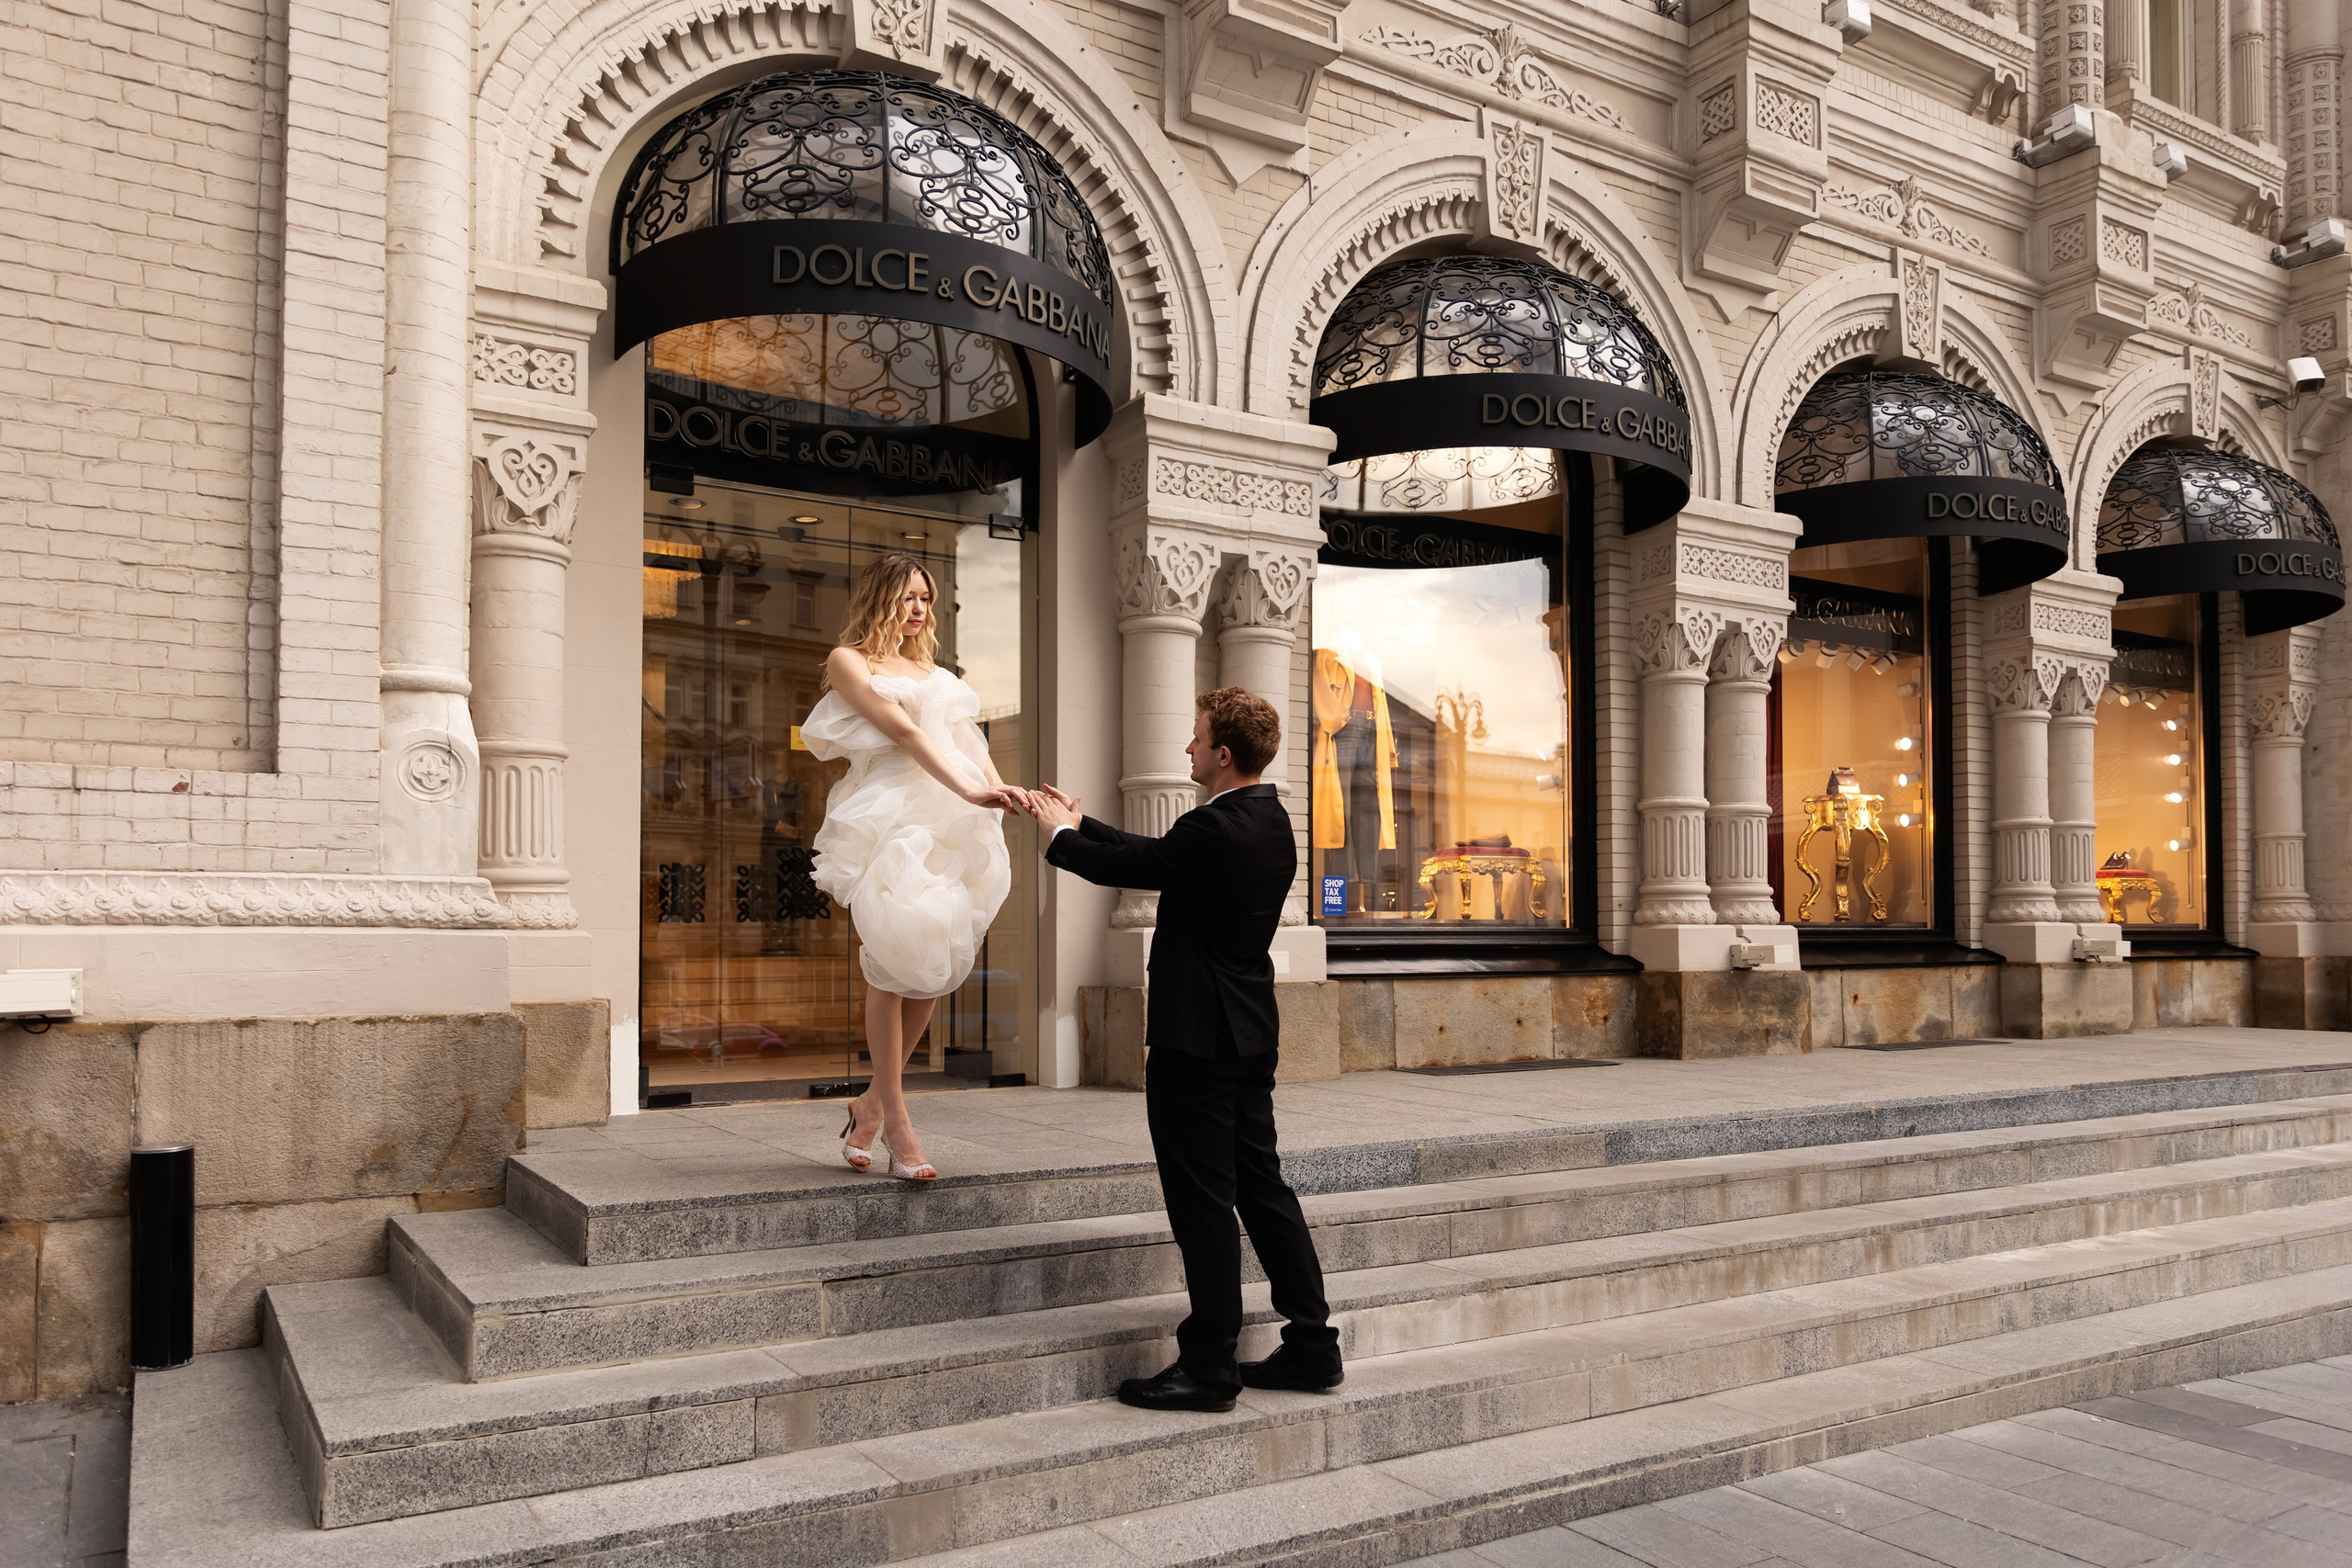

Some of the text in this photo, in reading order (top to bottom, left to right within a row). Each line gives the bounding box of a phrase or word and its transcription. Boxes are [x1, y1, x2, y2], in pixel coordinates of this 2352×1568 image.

[773, 243, 1112, 369] DOLCE & GABBANA
[1482, 393, 1693, 474] DOLCE & GABBAN
[647, 398, 1016, 496] DOLCE & GABBANA
[1928, 491, 2071, 540] DOLCE & GABB
[1399, 543, 1416, 563] &
[2238, 552, 2312, 576] DOLCE
[2313, 565, 2321, 578] &
[1324, 879, 1344, 888] SHOP
[1324, 887, 1340, 896] TAX
[1324, 896, 1342, 905] FREE
